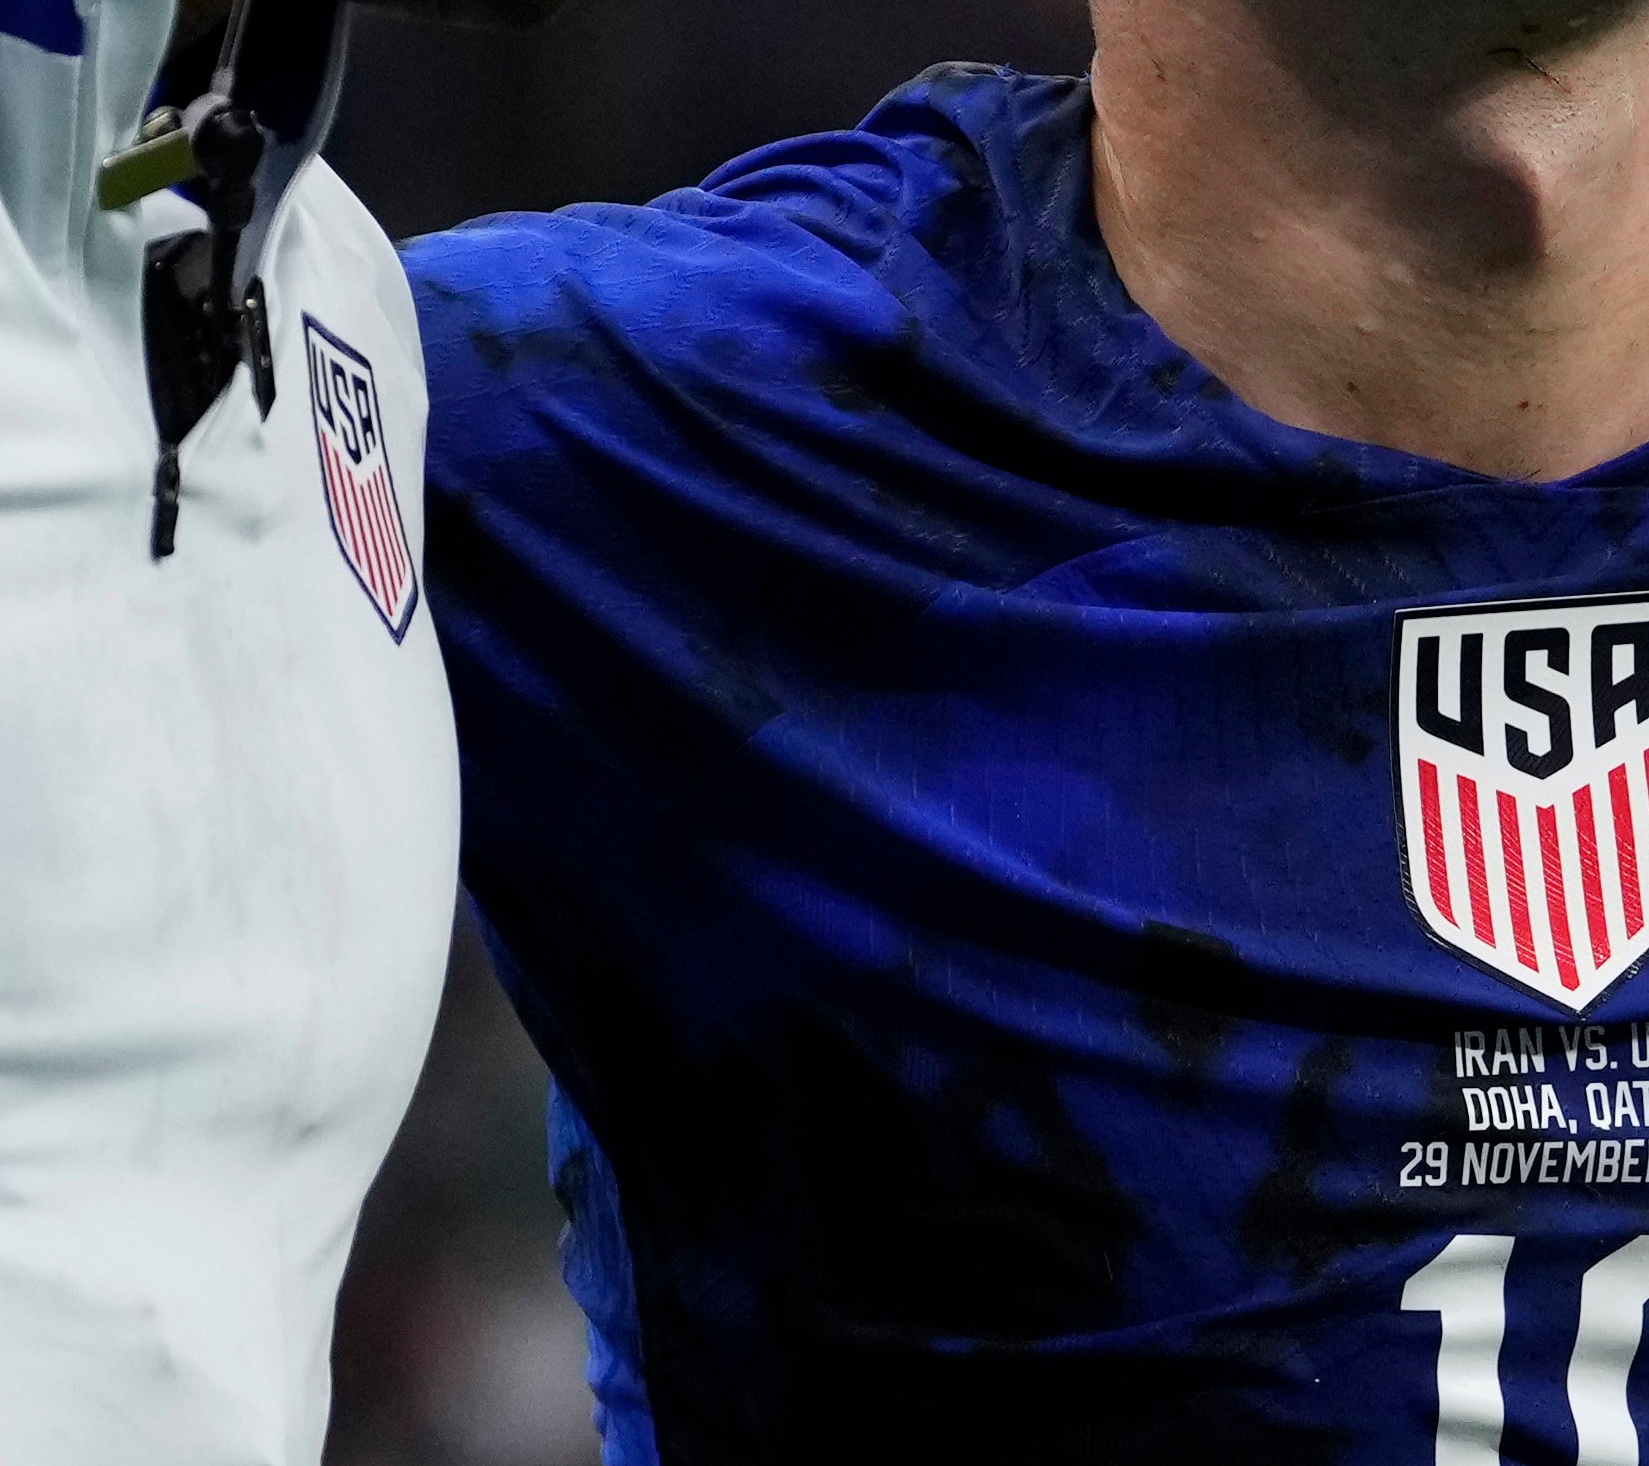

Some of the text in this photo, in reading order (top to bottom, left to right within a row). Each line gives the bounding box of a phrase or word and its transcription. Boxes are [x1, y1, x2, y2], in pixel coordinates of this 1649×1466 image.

[312, 343, 376, 465] USA
[1454, 1025, 1546, 1078] IRAN
[1559, 1025, 1618, 1073] VS.
[1462, 1083, 1578, 1135] DOHA,
[1399, 1141, 1449, 1187] 29
